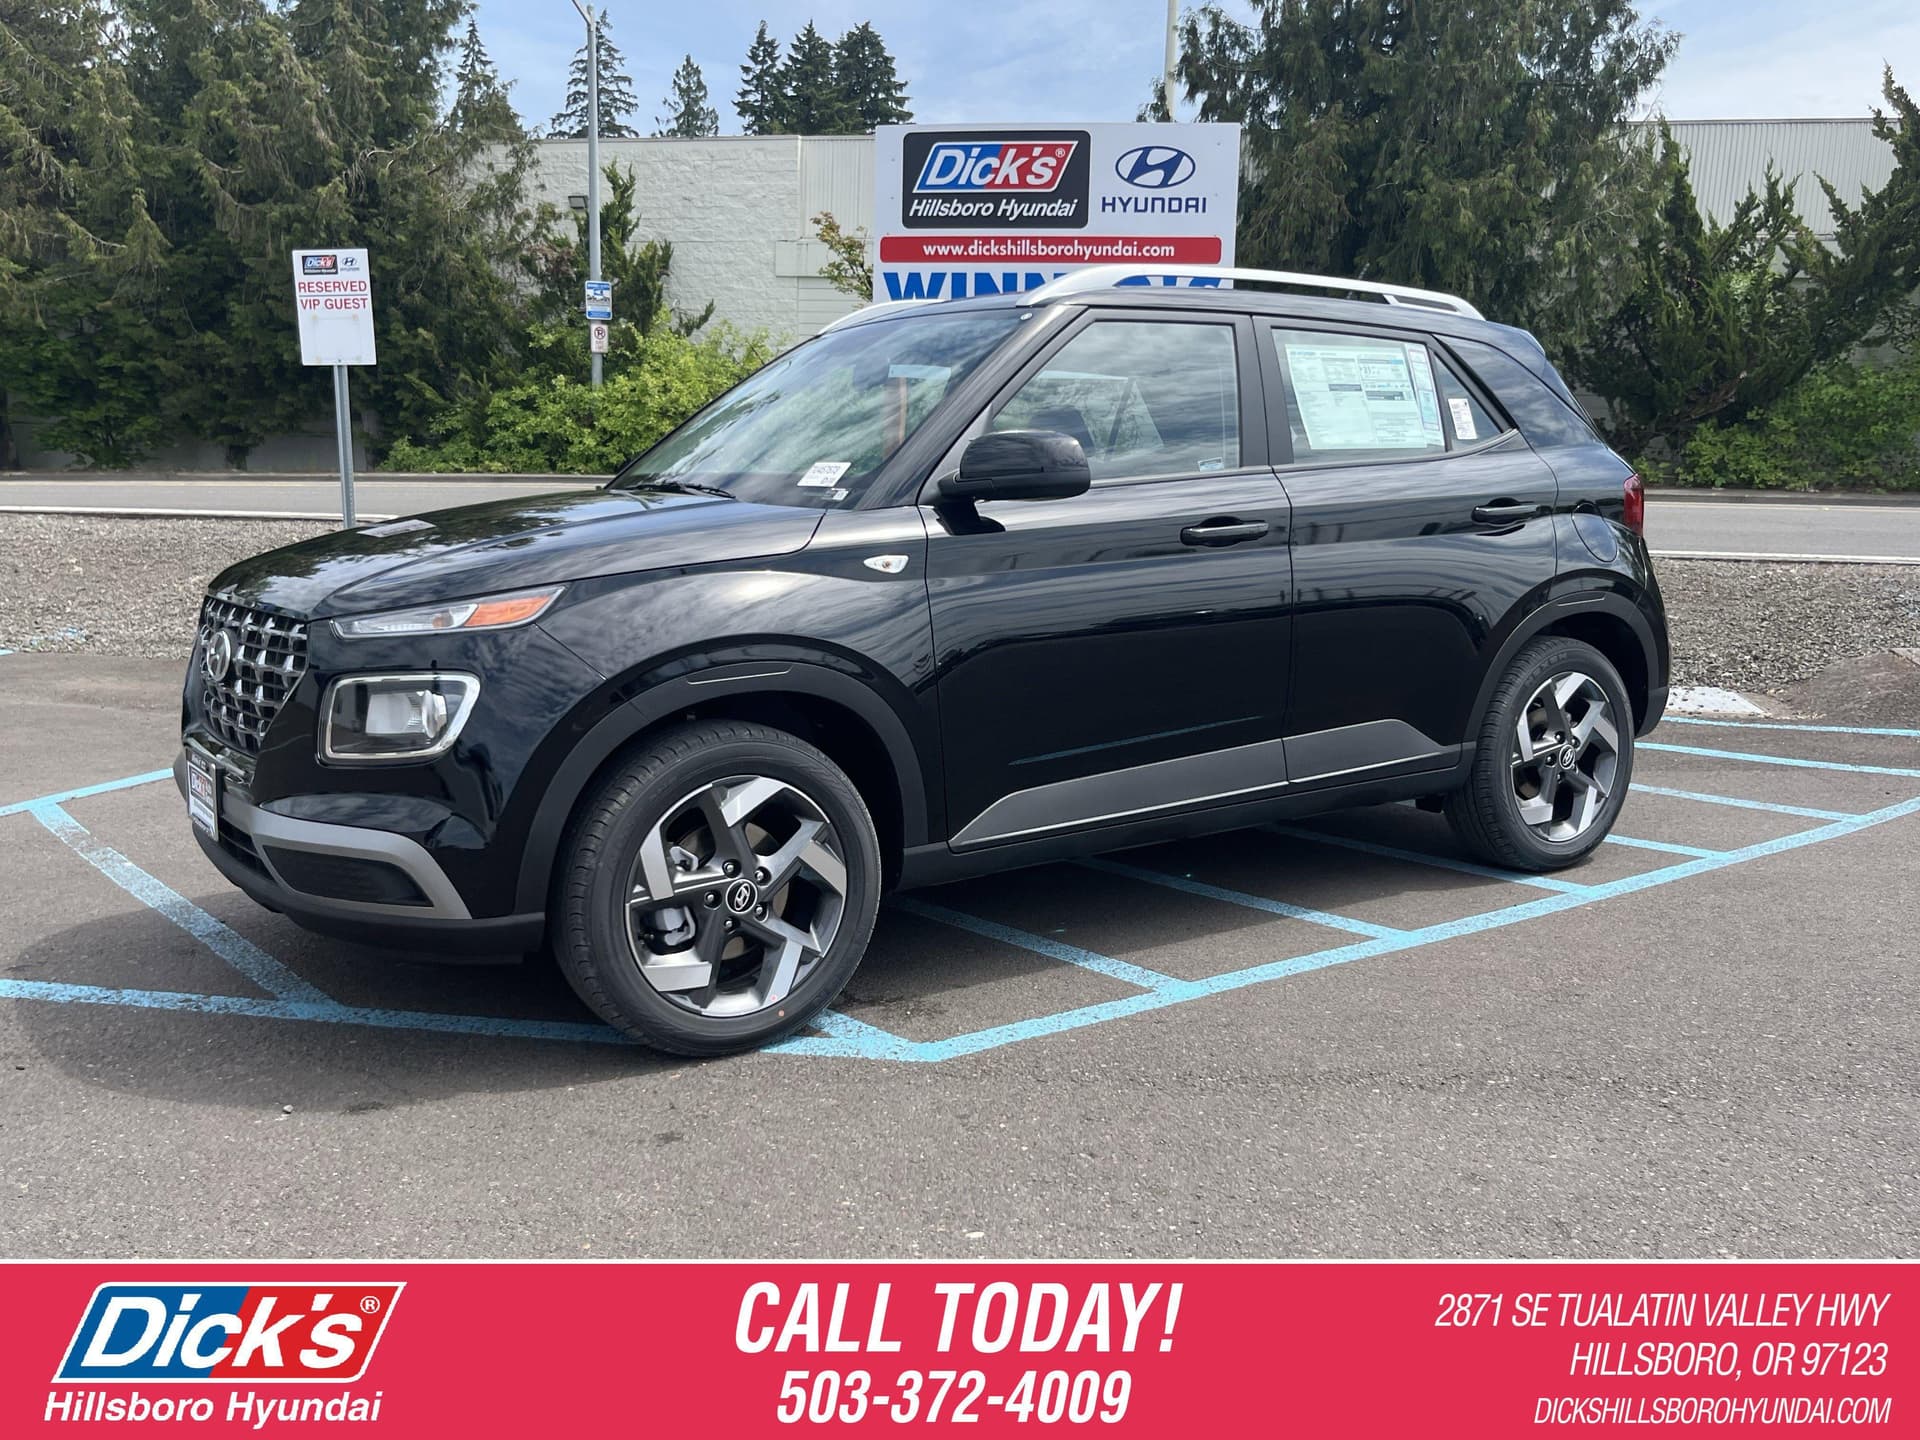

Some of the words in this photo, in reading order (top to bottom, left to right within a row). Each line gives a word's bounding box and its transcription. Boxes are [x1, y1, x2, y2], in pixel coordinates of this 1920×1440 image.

[909, 198, 994, 217] Hillsboro
[997, 198, 1078, 222] Hyundai
[1101, 196, 1207, 214] HYUNDAI
[923, 240, 1175, 261] www.dickshillsborohyundai.com
[298, 280, 368, 293] RESERVED
[300, 298, 321, 310] VIP
[324, 297, 369, 310] GUEST
